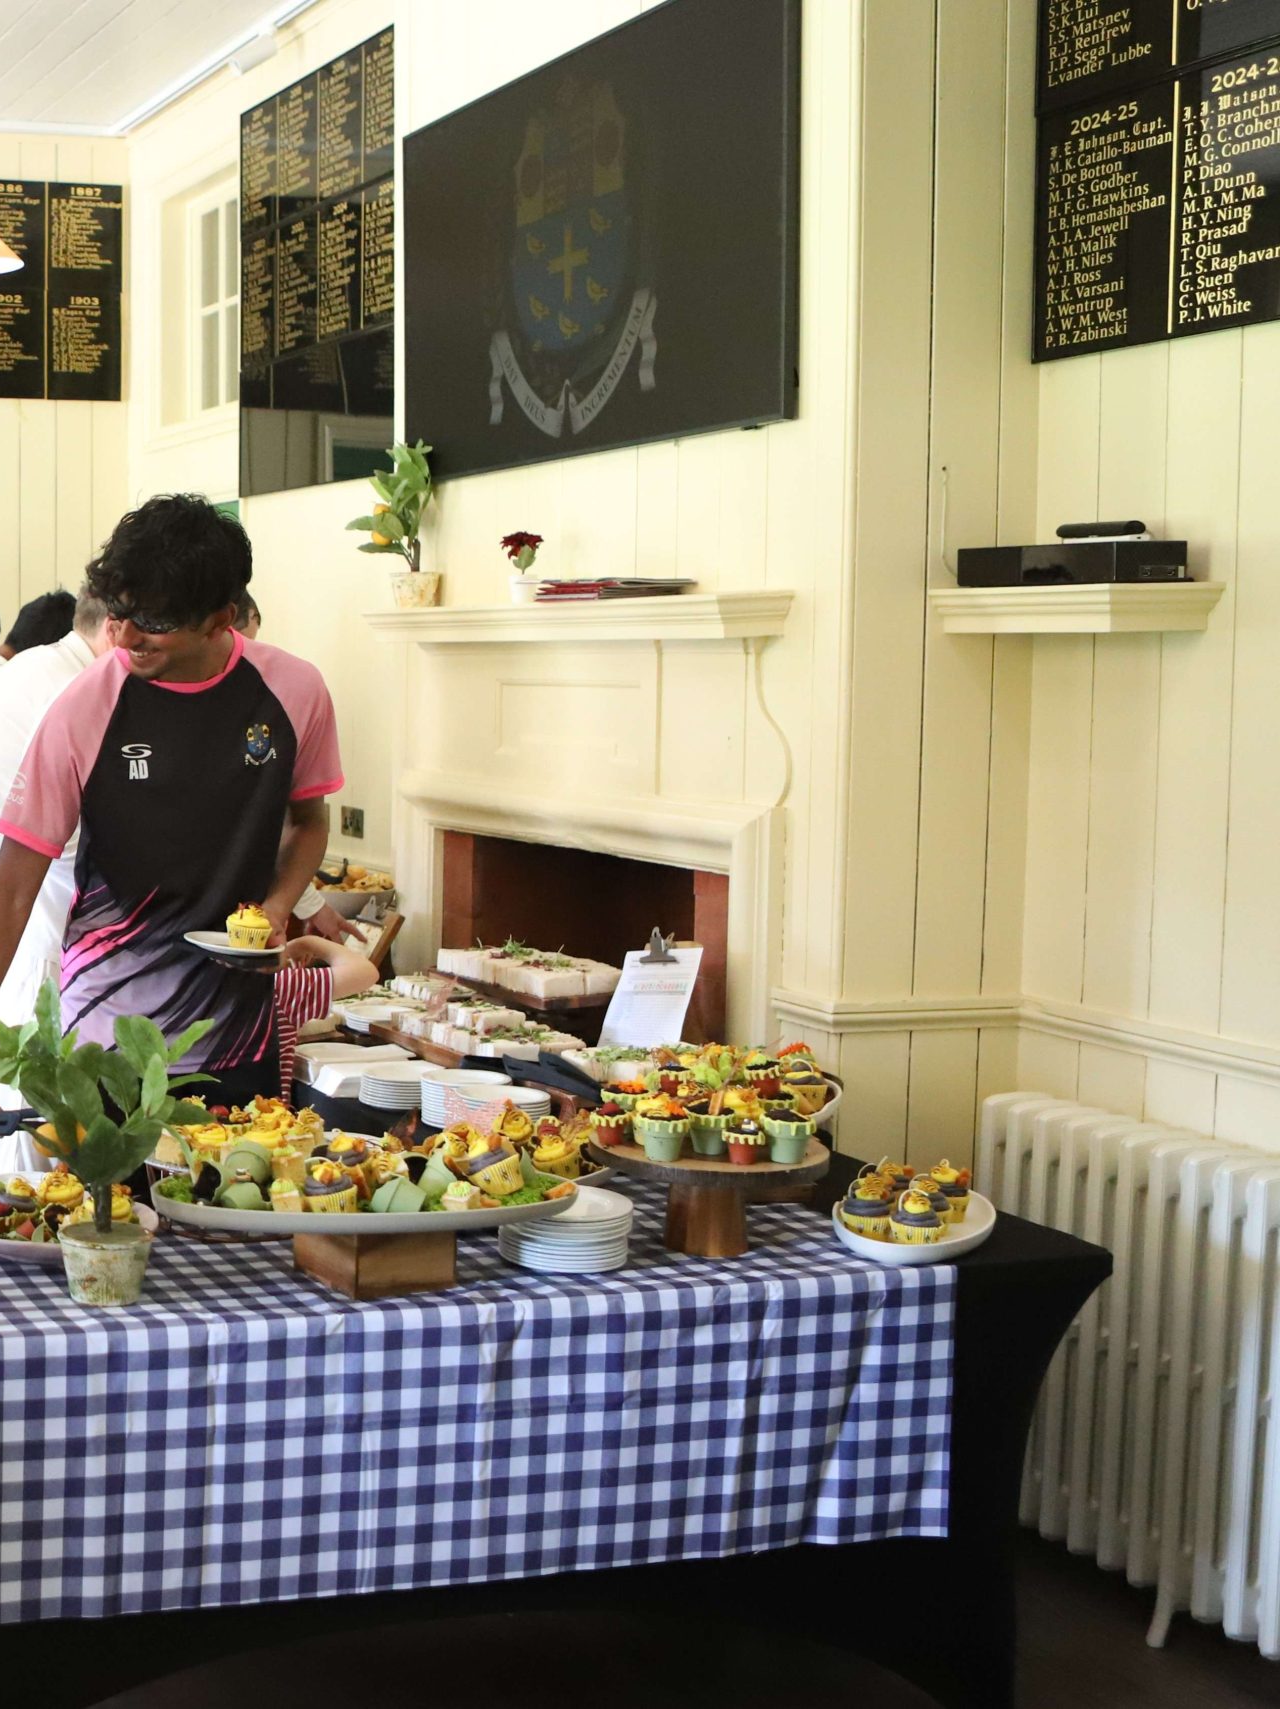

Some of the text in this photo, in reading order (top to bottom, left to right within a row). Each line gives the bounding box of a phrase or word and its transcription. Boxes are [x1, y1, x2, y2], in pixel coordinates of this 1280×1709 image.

[1048, 8, 1131, 47] I. S. Matsnev
[1049, 5, 1099, 32] S. K. Lui
[1049, 21, 1132, 60] R. J. Renfrew
[1048, 40, 1111, 74] J. P. Segal
[1111, 43, 1152, 66] Lubbe
[1211, 57, 1280, 93] 2024-2
[1070, 101, 1138, 136] 2024-25
[1184, 122, 1197, 137] T.
[1200, 117, 1214, 132] Y.
[1049, 131, 1173, 176] M. K. Catallo-Bauman
[1184, 138, 1198, 152] E.
[1200, 133, 1215, 148] O.
[1217, 128, 1232, 143] C.
[1184, 152, 1202, 169] M.
[1204, 147, 1219, 162] G.
[1048, 160, 1123, 190] S. De Botton
[1183, 161, 1232, 184] P. Diao
[1183, 171, 1256, 200] A. I. Dunn
[70, 187, 102, 197] 1887
[1048, 183, 1150, 219] H. F. G. Hawkins
[1049, 171, 1139, 205] M. I. S. Godber
[1182, 185, 1266, 215] M. R. M. Ma
[1047, 194, 1166, 234] L. B. Hemashabeshan
[1182, 204, 1252, 231] H. Y. Ning
[1048, 215, 1129, 248] A. J. A. Jewell
[1181, 219, 1248, 246] R. Prasad
[1047, 233, 1118, 262] A. M. Malik
[1180, 242, 1221, 261] T. Qiu
[1047, 251, 1113, 276] W. H. Niles
[1180, 264, 1192, 278] L.
[1195, 260, 1208, 275] S.
[1046, 269, 1102, 291] A. J. Ross
[1046, 276, 1124, 306] R. K. Varsani
[1179, 272, 1233, 293] G. Suen
[70, 296, 100, 306] 1903
[1046, 296, 1114, 320] J. Wentrup
[1178, 286, 1236, 308] C. Weiss
[1046, 307, 1128, 334] A. W. M. West
[1178, 299, 1252, 324] P. J. White
[1045, 320, 1128, 349] P. B. Zabinski
[129, 759, 149, 780] AD
